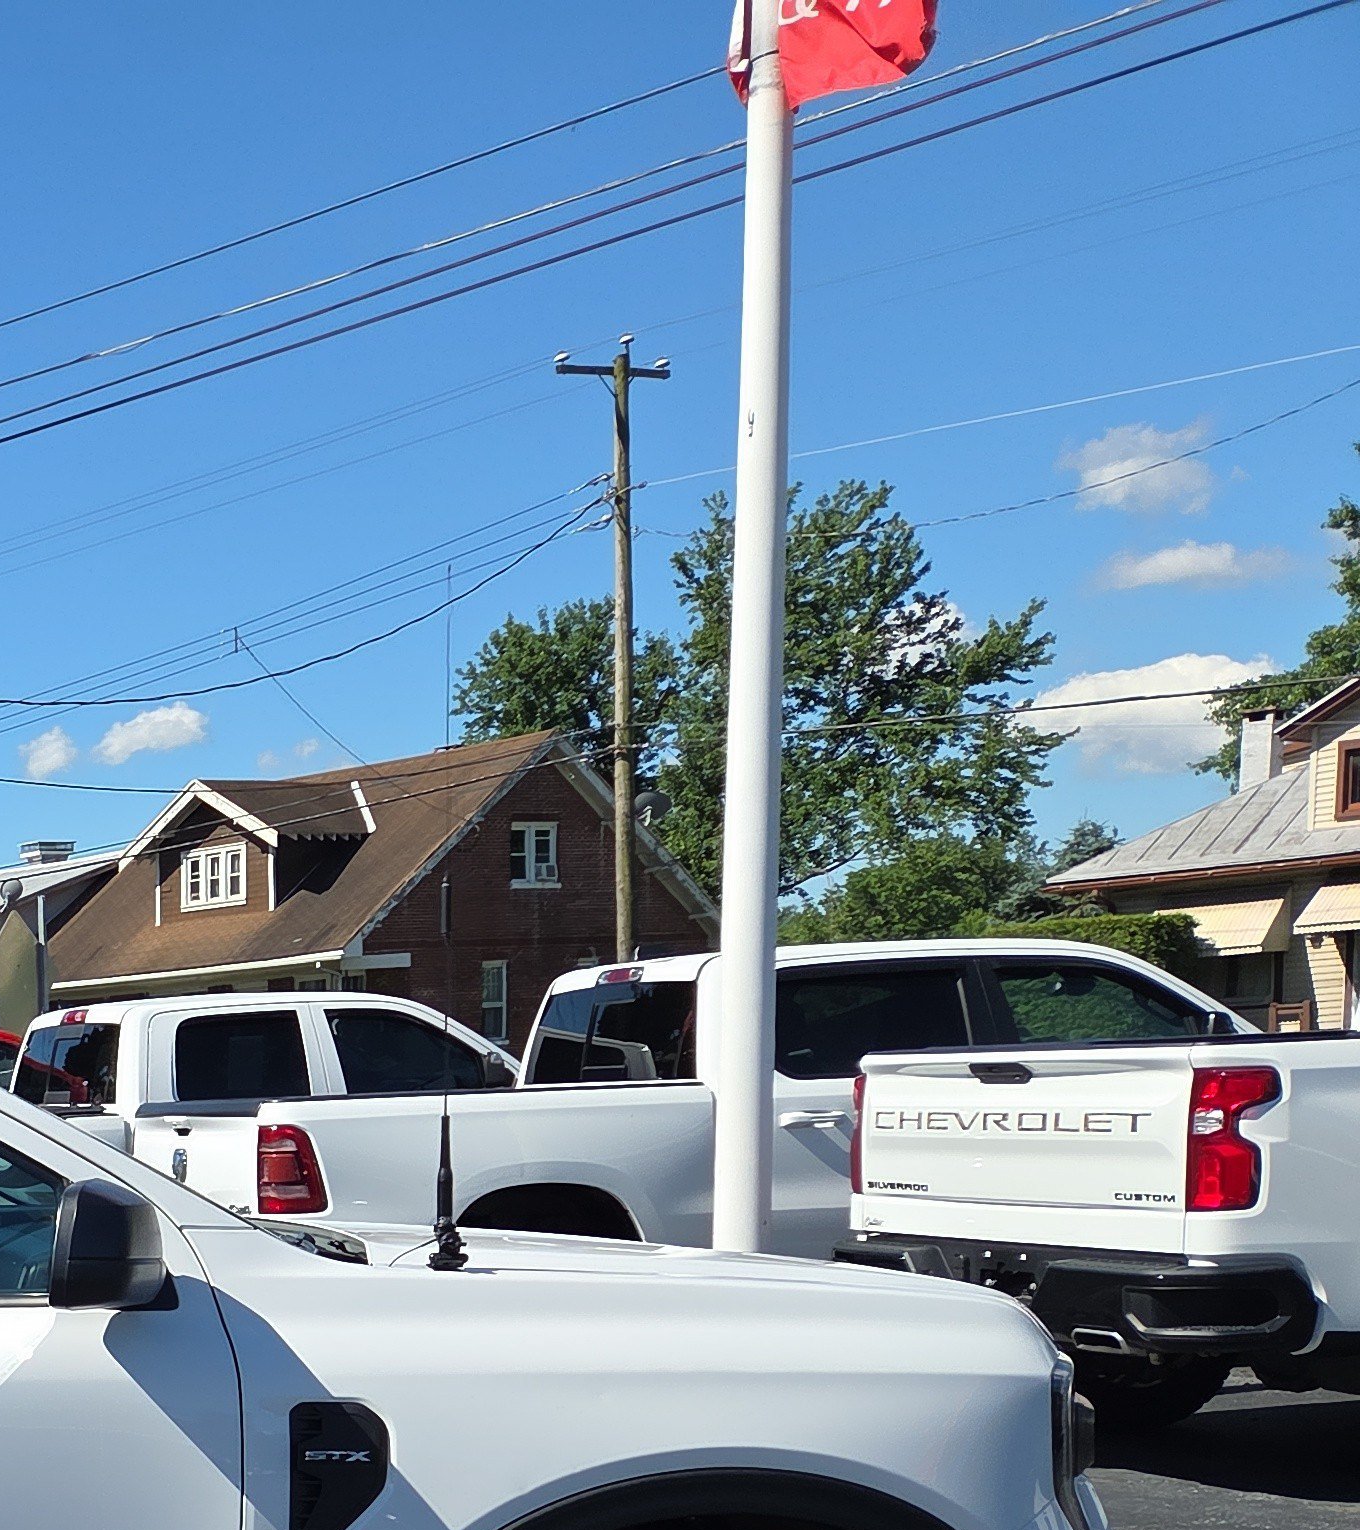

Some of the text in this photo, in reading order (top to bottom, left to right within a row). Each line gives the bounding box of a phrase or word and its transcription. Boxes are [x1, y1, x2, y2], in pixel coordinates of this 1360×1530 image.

[875, 1111, 1152, 1133] CHEVROLET
[867, 1181, 929, 1192] SILVERADO
[1114, 1193, 1176, 1203] CUSTOM
[305, 1451, 371, 1462] STX
